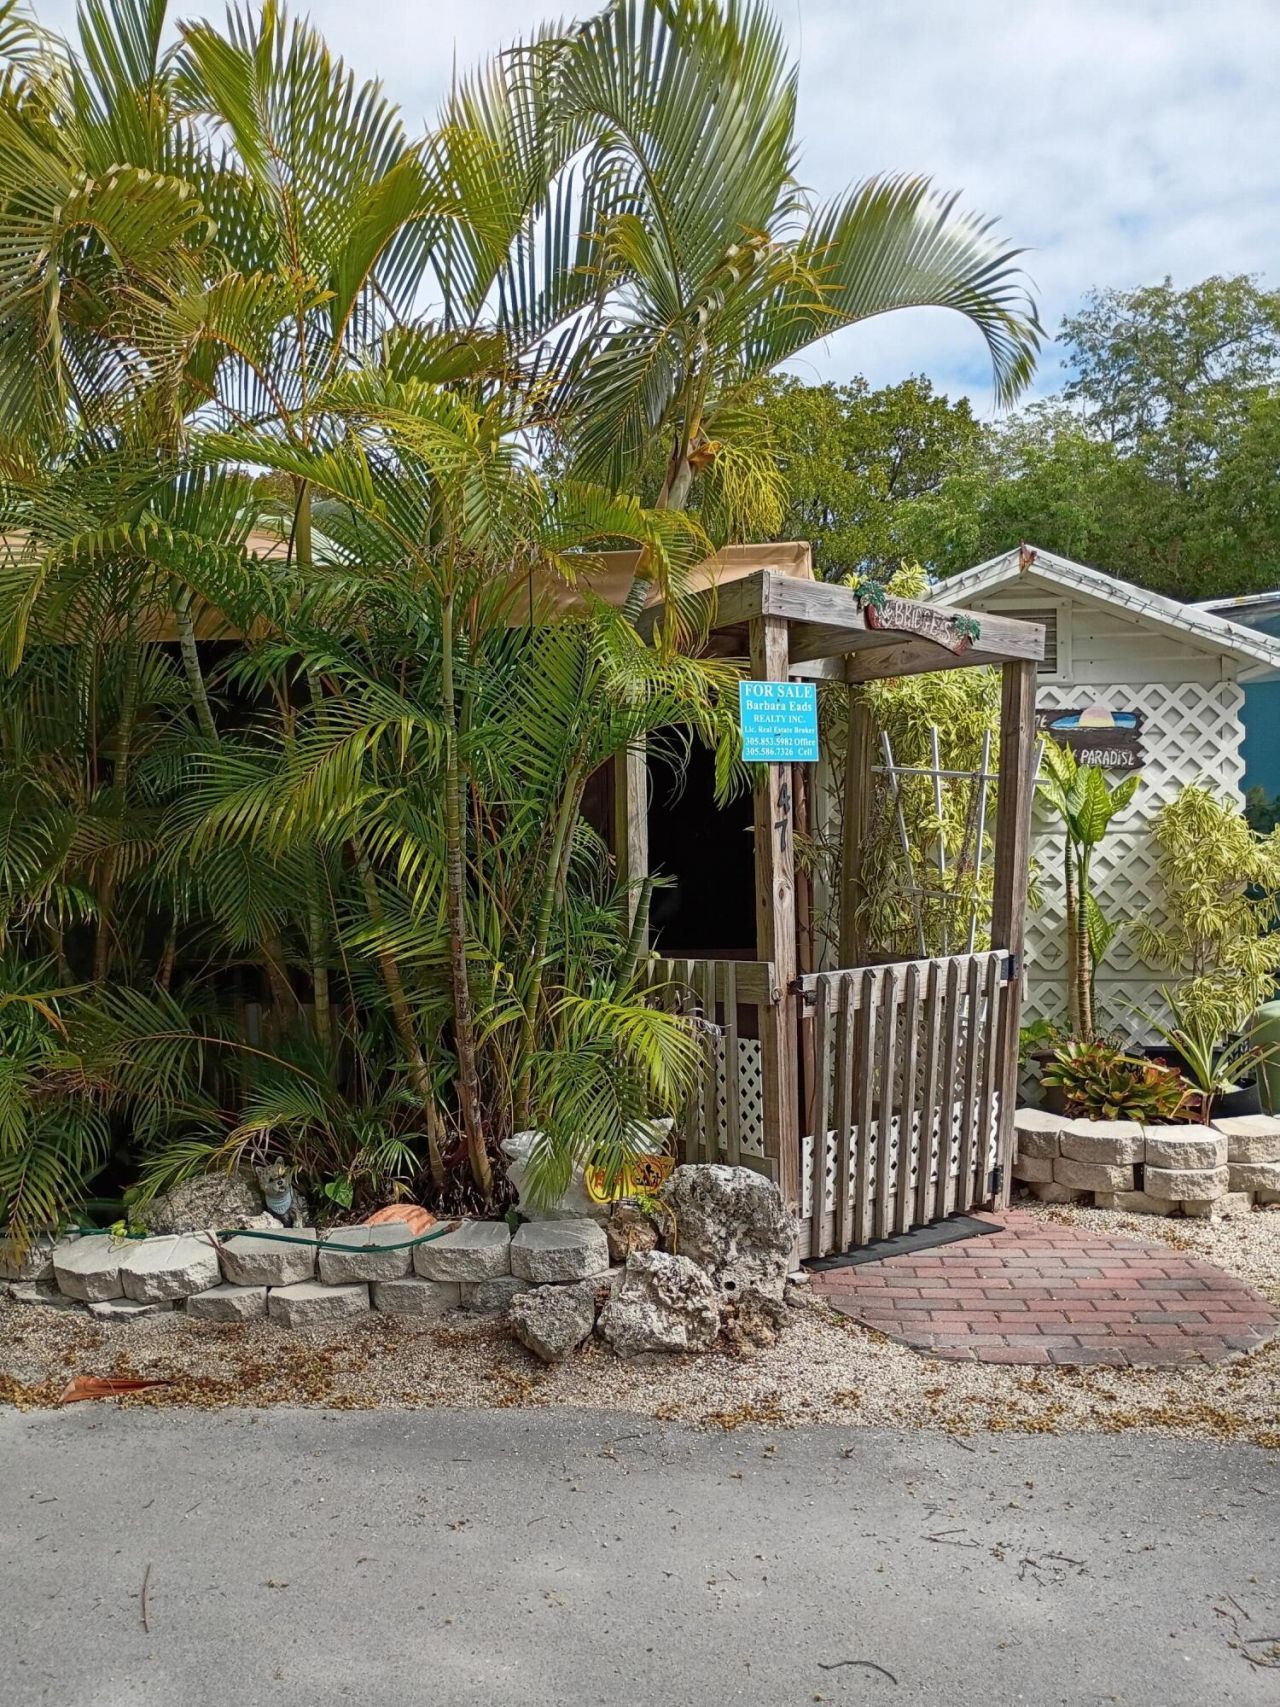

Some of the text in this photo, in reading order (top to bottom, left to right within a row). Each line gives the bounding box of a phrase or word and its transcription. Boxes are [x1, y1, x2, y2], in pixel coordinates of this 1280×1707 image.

[745, 684, 812, 698] FOR SALE
[746, 700, 812, 712] Barbara Eads
[753, 714, 806, 723] REALTY INC.
[773, 726, 793, 734] Estate
[794, 738, 816, 746] Office
[797, 748, 812, 756] Cell
